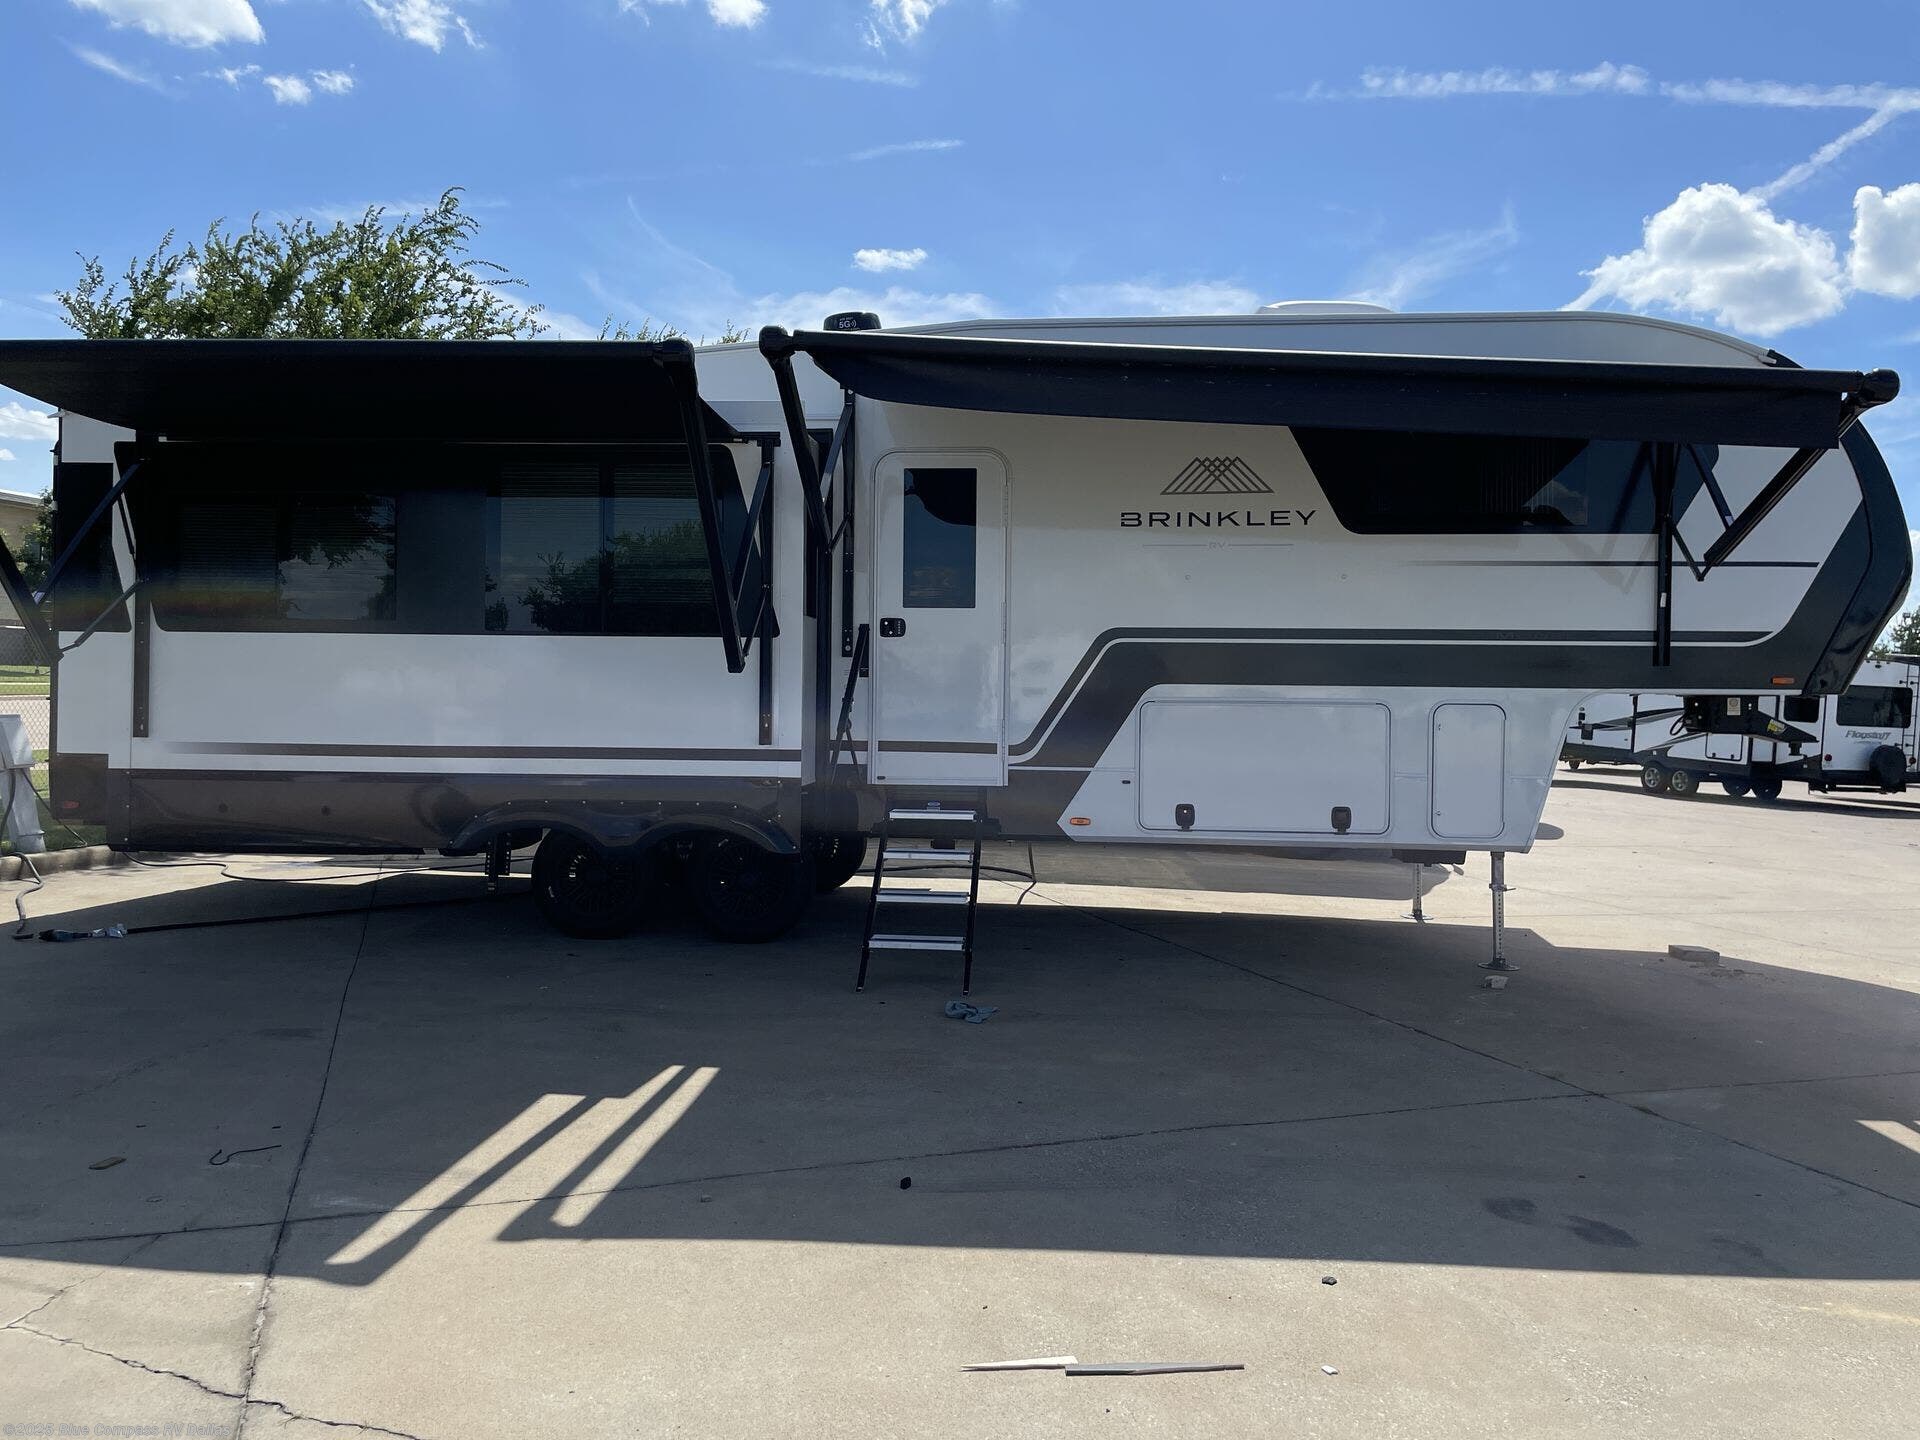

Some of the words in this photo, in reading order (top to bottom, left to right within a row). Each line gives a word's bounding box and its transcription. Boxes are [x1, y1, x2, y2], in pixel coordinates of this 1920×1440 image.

[839, 320, 851, 329] 5G
[1120, 510, 1317, 527] BRINKLEY
[1209, 541, 1226, 550] RV
